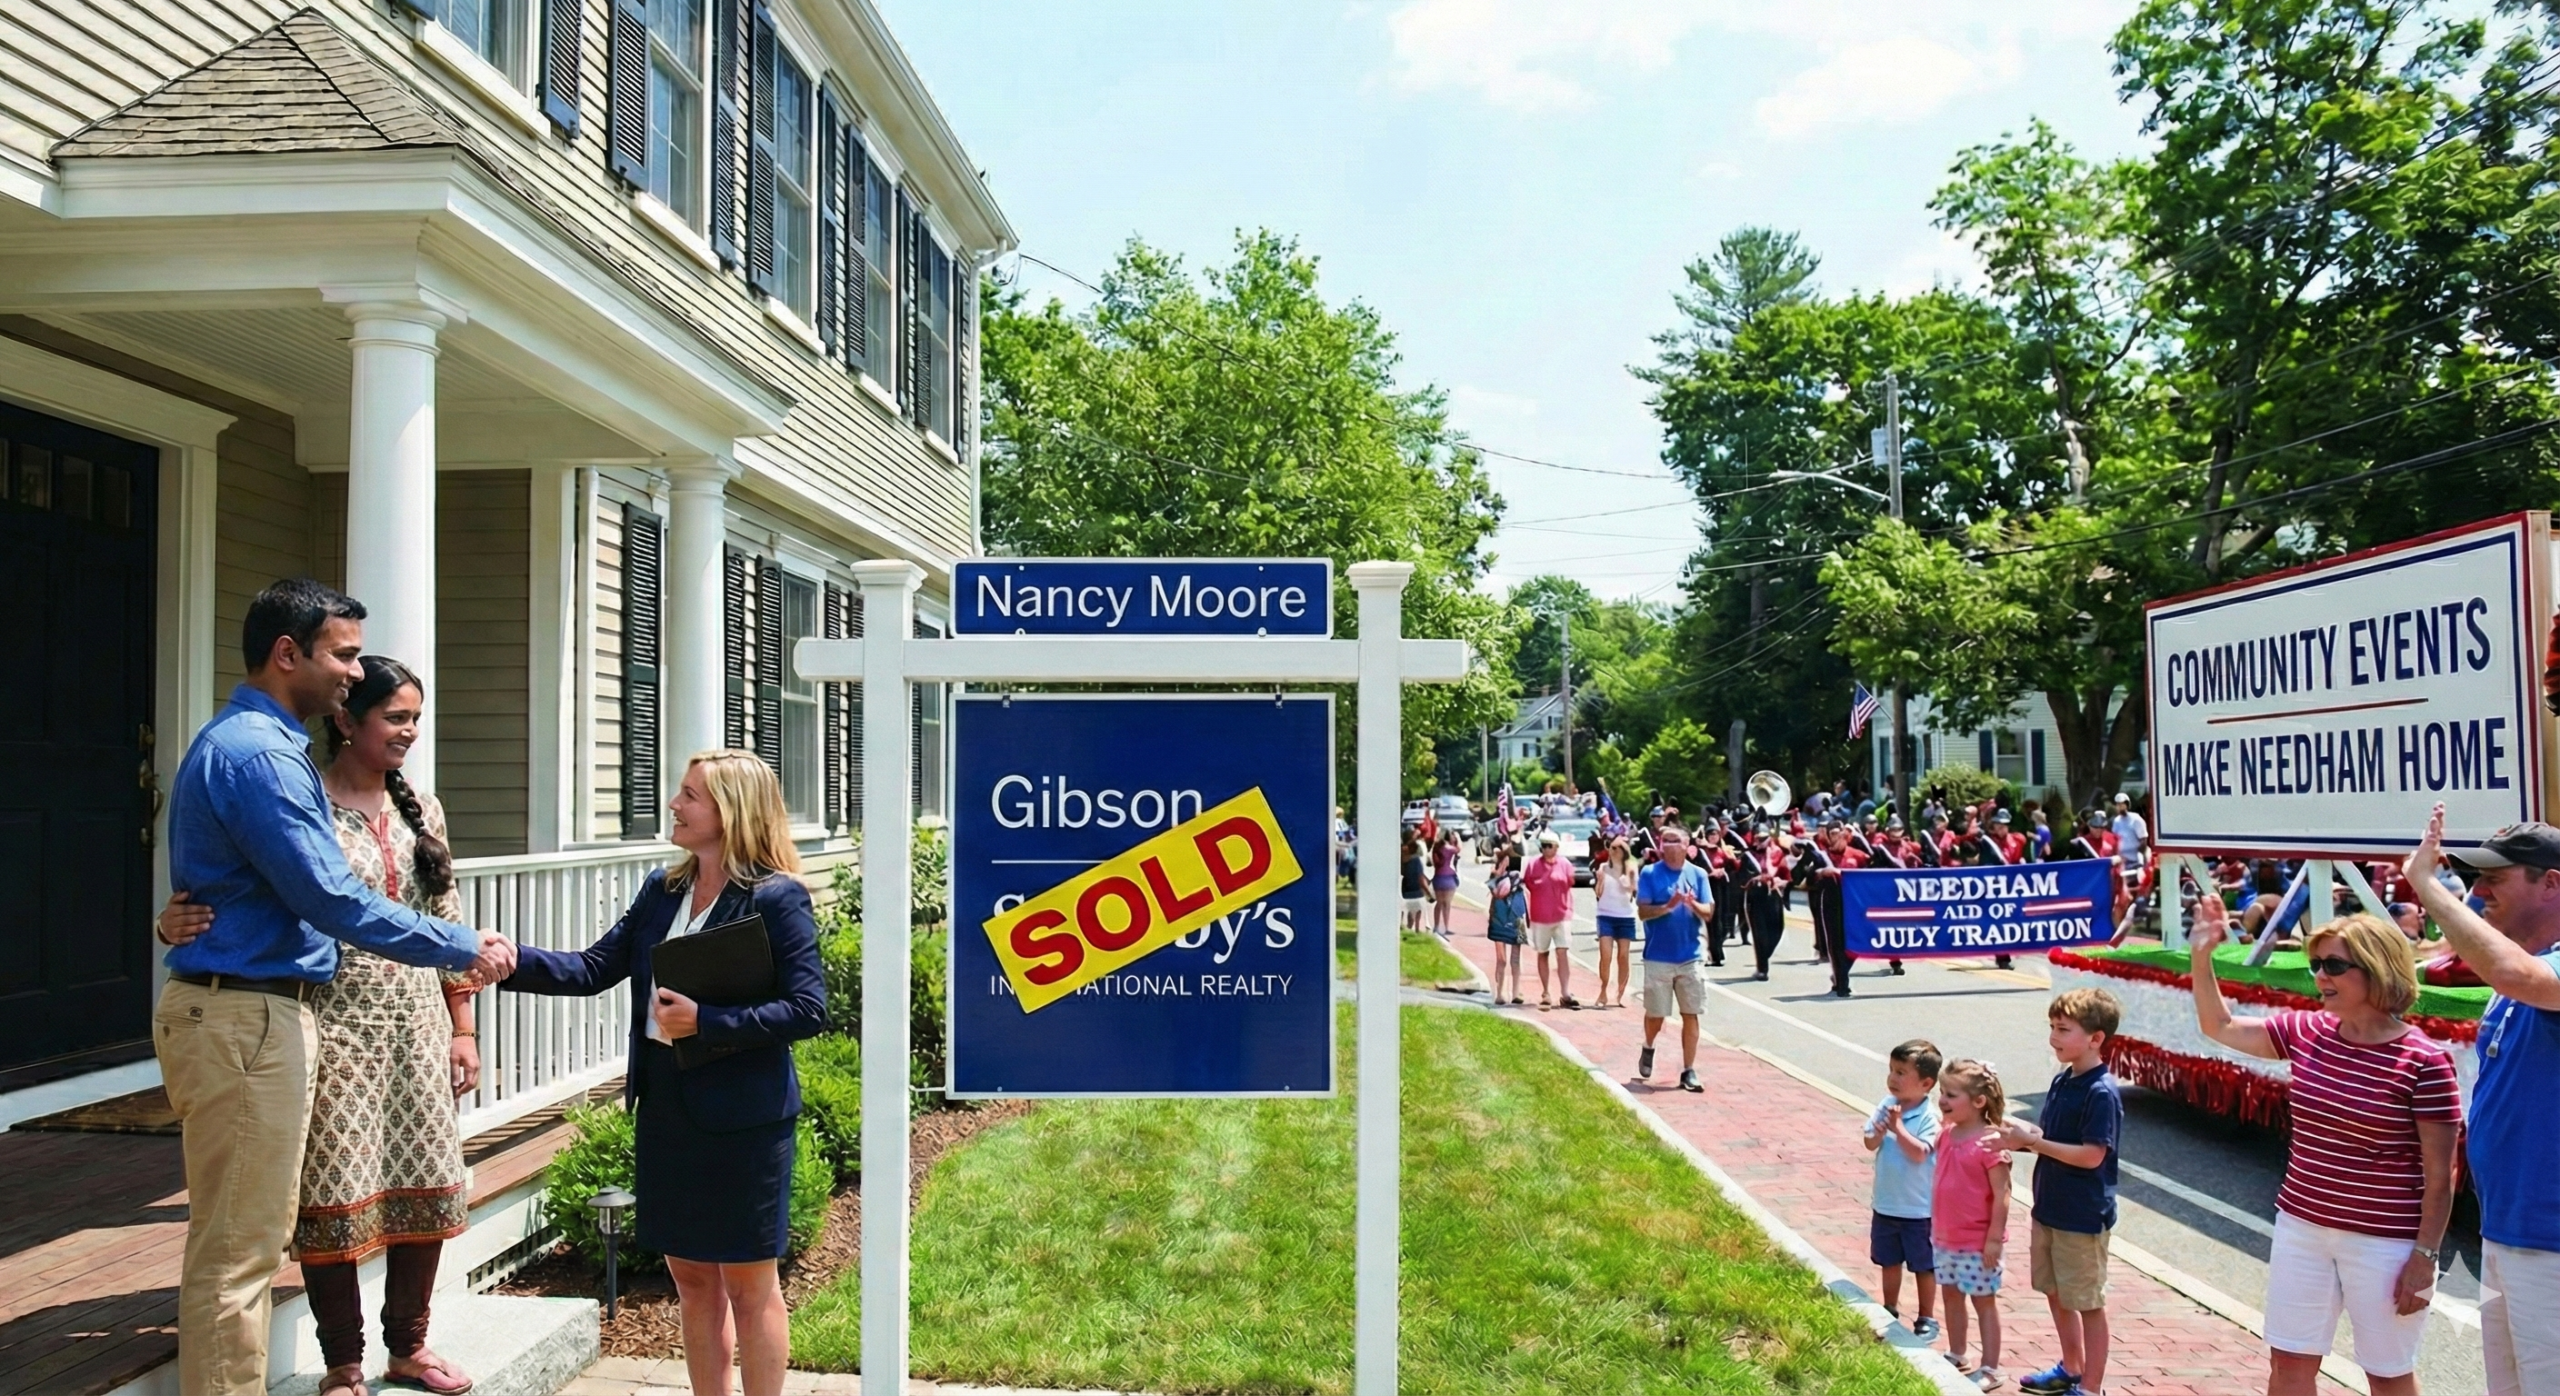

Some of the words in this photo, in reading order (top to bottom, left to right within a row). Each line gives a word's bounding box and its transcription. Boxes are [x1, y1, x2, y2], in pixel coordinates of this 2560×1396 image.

[977, 575, 1134, 628] Nancy
[1151, 575, 1308, 619] Moore
[2167, 625, 2337, 708] COMMUNITY
[2349, 596, 2492, 687] EVENTS
[2163, 739, 2233, 798] MAKE
[2240, 726, 2386, 796] NEEDHAM
[2398, 716, 2512, 793] HOME
[991, 774, 1203, 830] Gibson
[1010, 816, 1273, 985] SOLD
[1894, 871, 2061, 903] NEEDHAM
[1987, 902, 2018, 921] OF
[1870, 925, 1941, 950] JULY
[1946, 917, 2093, 948] TRADITION
[989, 973, 1194, 998] INATIONAL
[1200, 973, 1294, 998] REALTY
